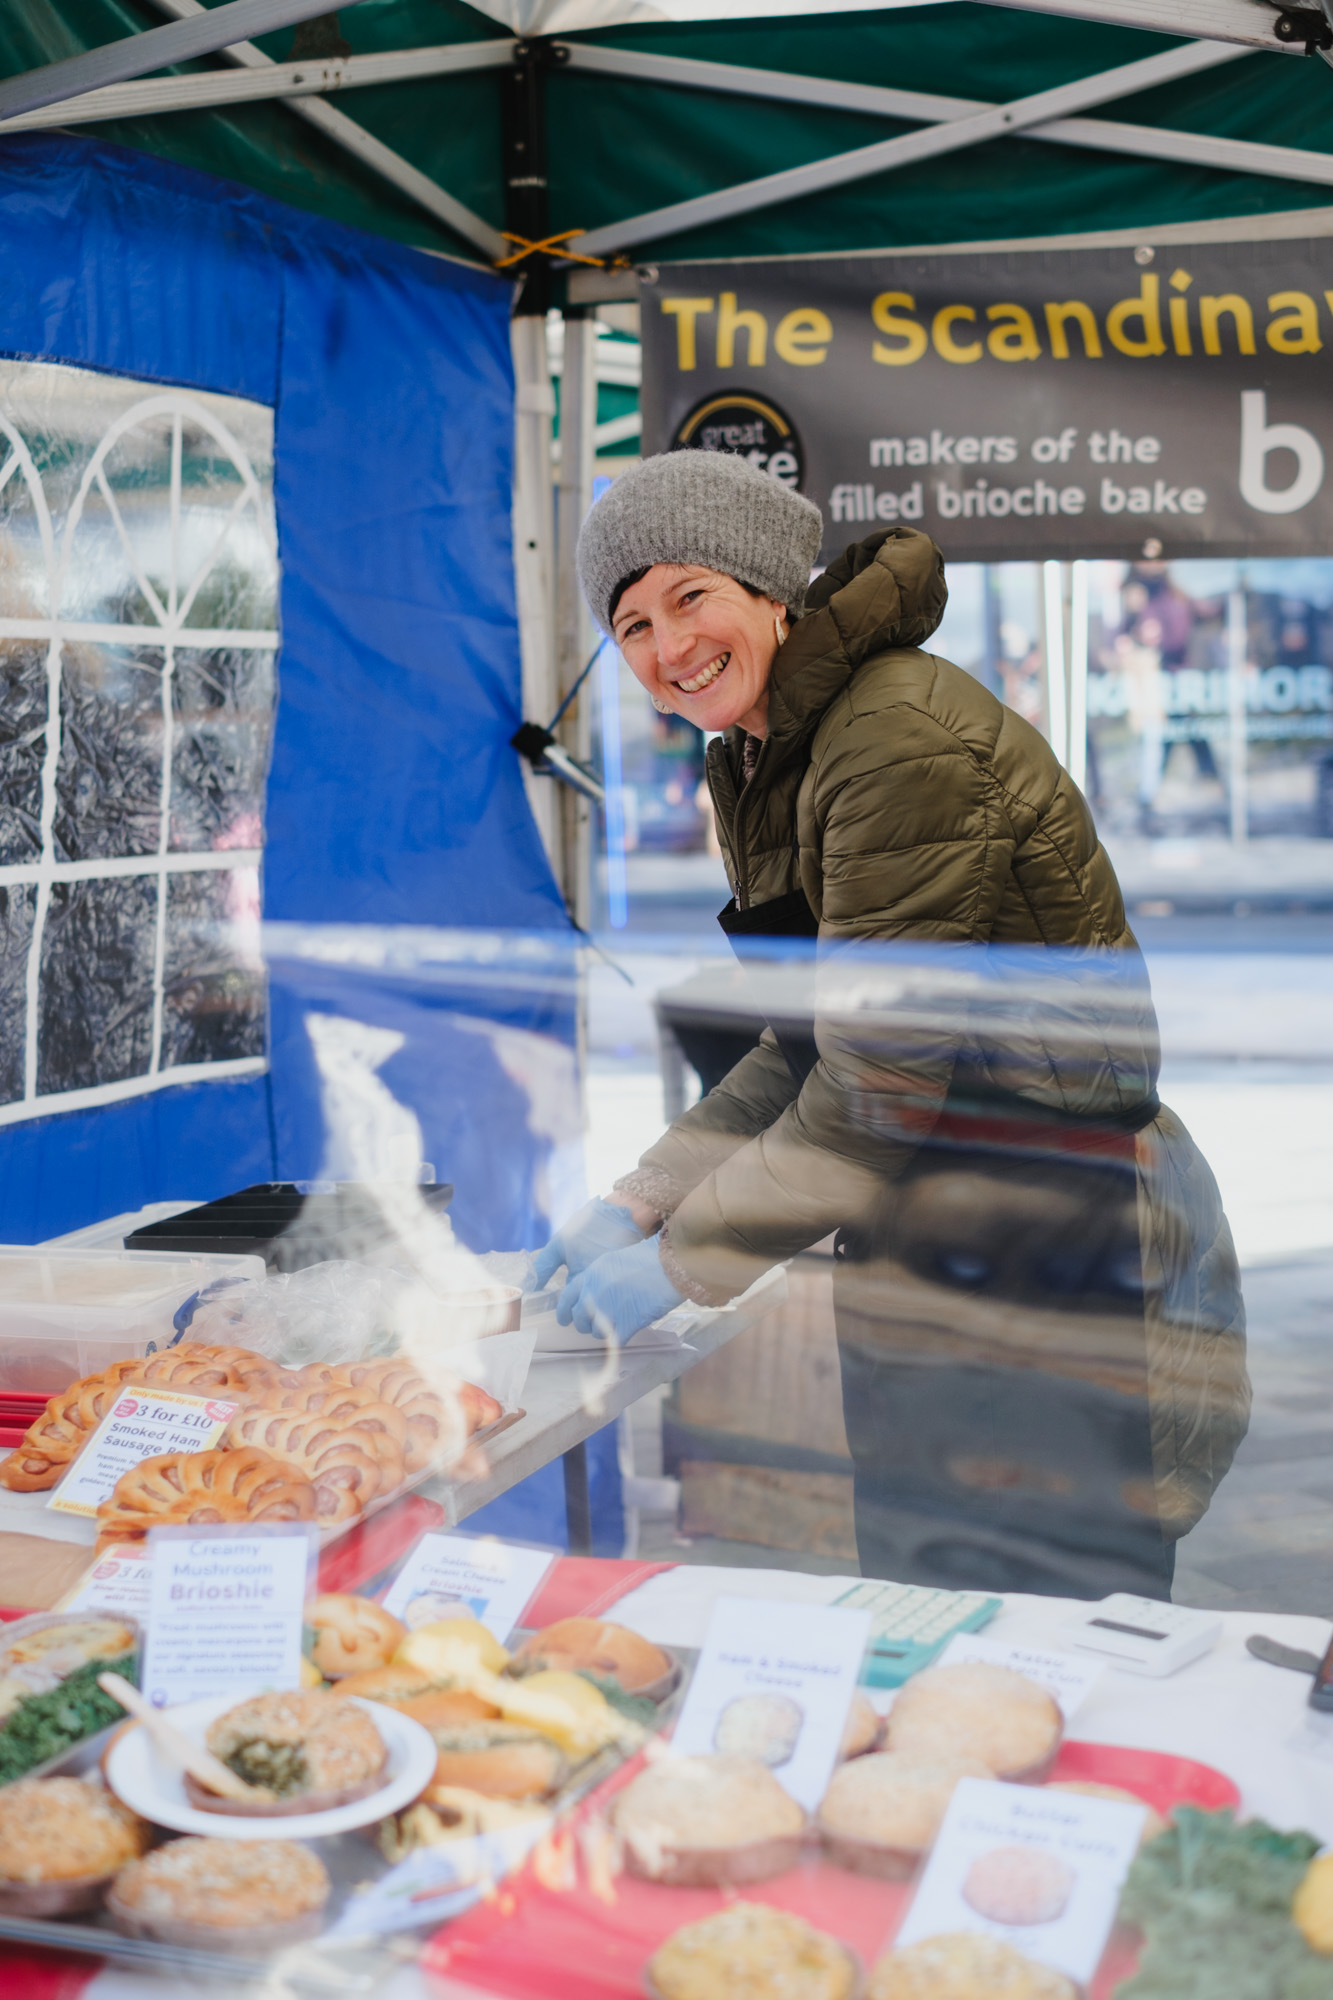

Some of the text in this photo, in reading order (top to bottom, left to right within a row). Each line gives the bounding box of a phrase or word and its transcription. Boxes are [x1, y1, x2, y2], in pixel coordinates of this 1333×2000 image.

[661, 268, 1333, 371] The Scandina
[869, 427, 1161, 467] makers of the
[829, 479, 1208, 523] filled brioche bake
[136, 1404, 214, 1429] 3 for £10
[103, 1435, 162, 1457] Sausage
[110, 1422, 201, 1448] Smoked Ham
[189, 1541, 262, 1558] Creamy
[173, 1563, 274, 1577] Mushroom
[170, 1580, 275, 1601] Brioshie
